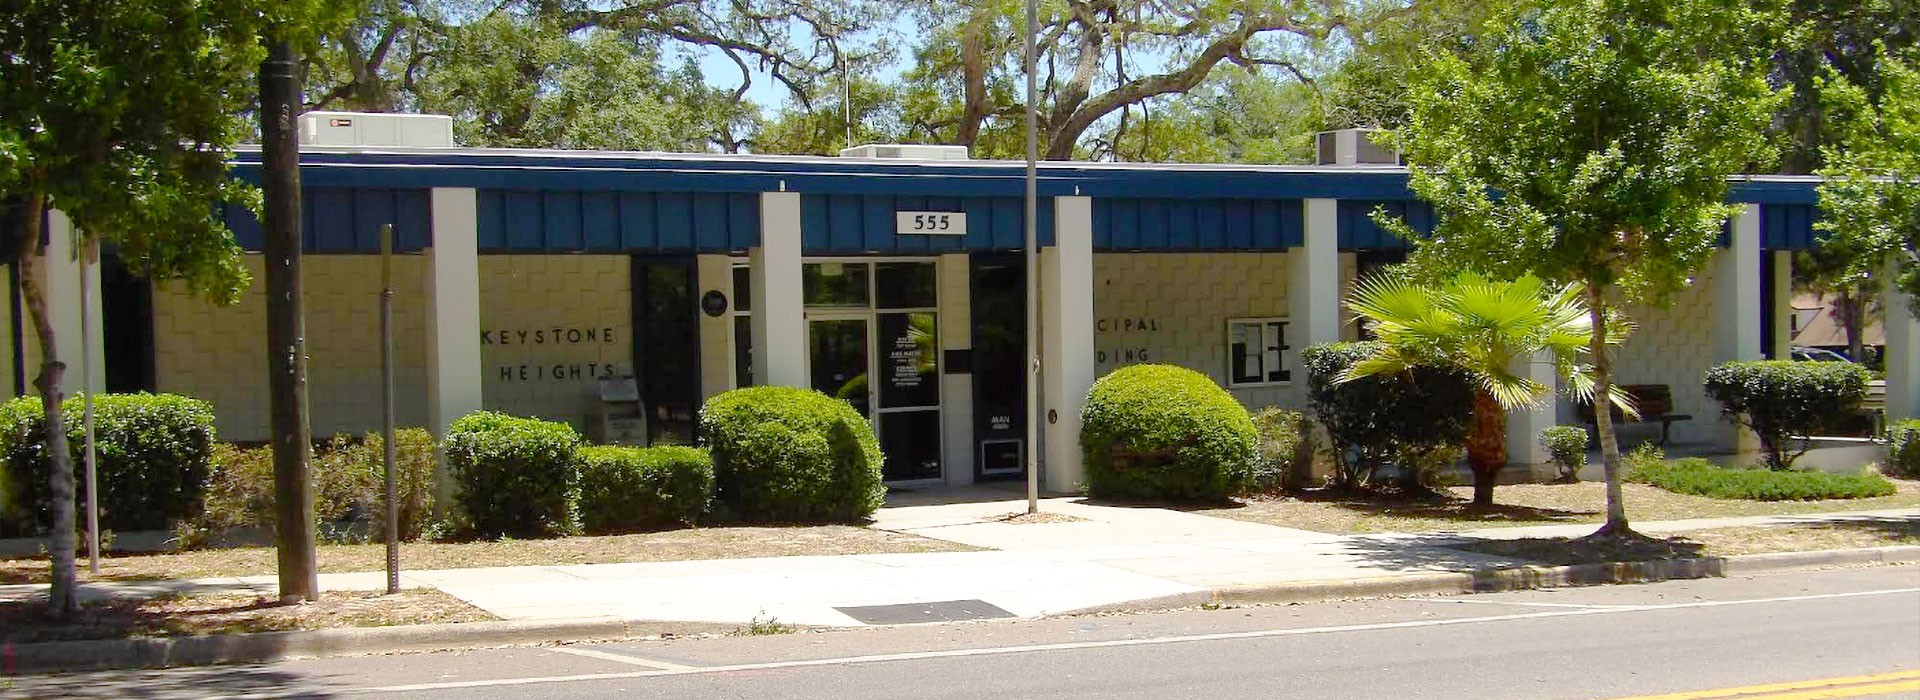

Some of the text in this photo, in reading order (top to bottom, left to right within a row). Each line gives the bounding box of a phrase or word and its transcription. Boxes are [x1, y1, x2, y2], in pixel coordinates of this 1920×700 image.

[914, 214, 949, 230] 555
[481, 328, 614, 345] KEYSTONE
[500, 364, 613, 381] HEIGHTS
